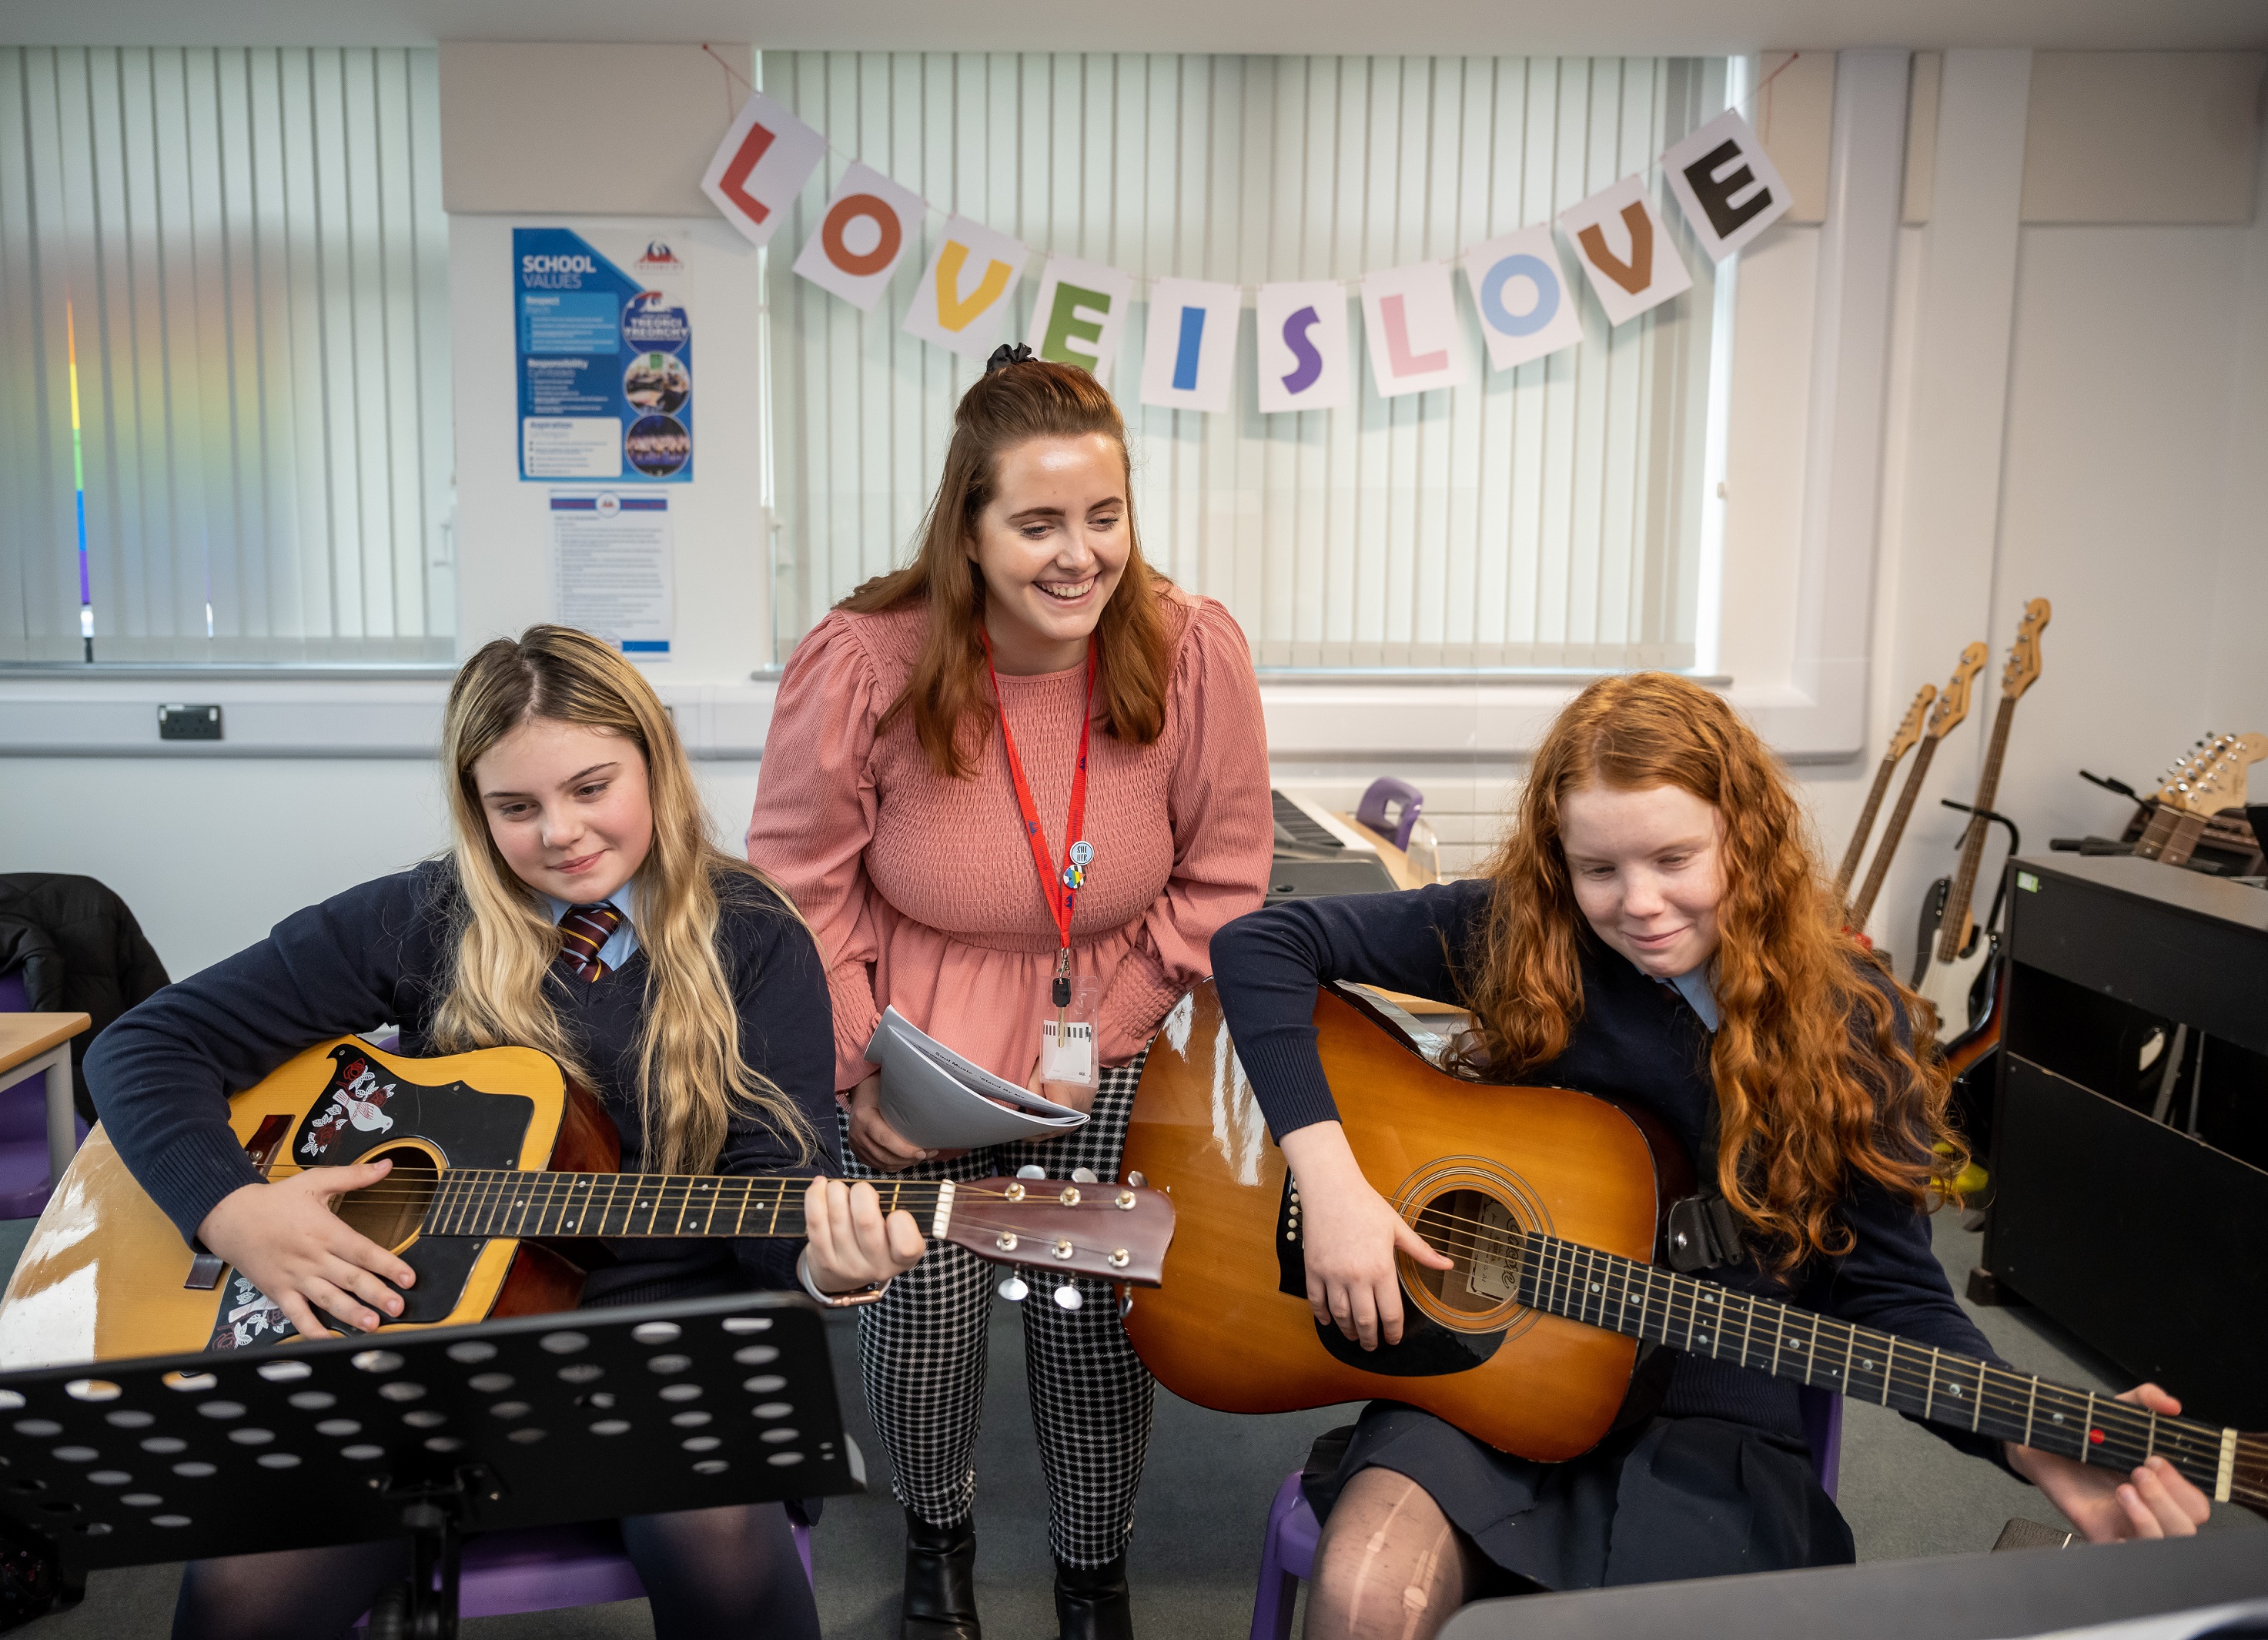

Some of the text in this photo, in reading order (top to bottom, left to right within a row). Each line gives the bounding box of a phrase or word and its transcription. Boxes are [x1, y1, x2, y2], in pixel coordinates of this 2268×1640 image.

[522, 255, 597, 273] SCHOOL
[522, 273, 582, 289] VALUES
[935, 1051, 951, 1063] Soul
[952, 1062, 972, 1075] Music
